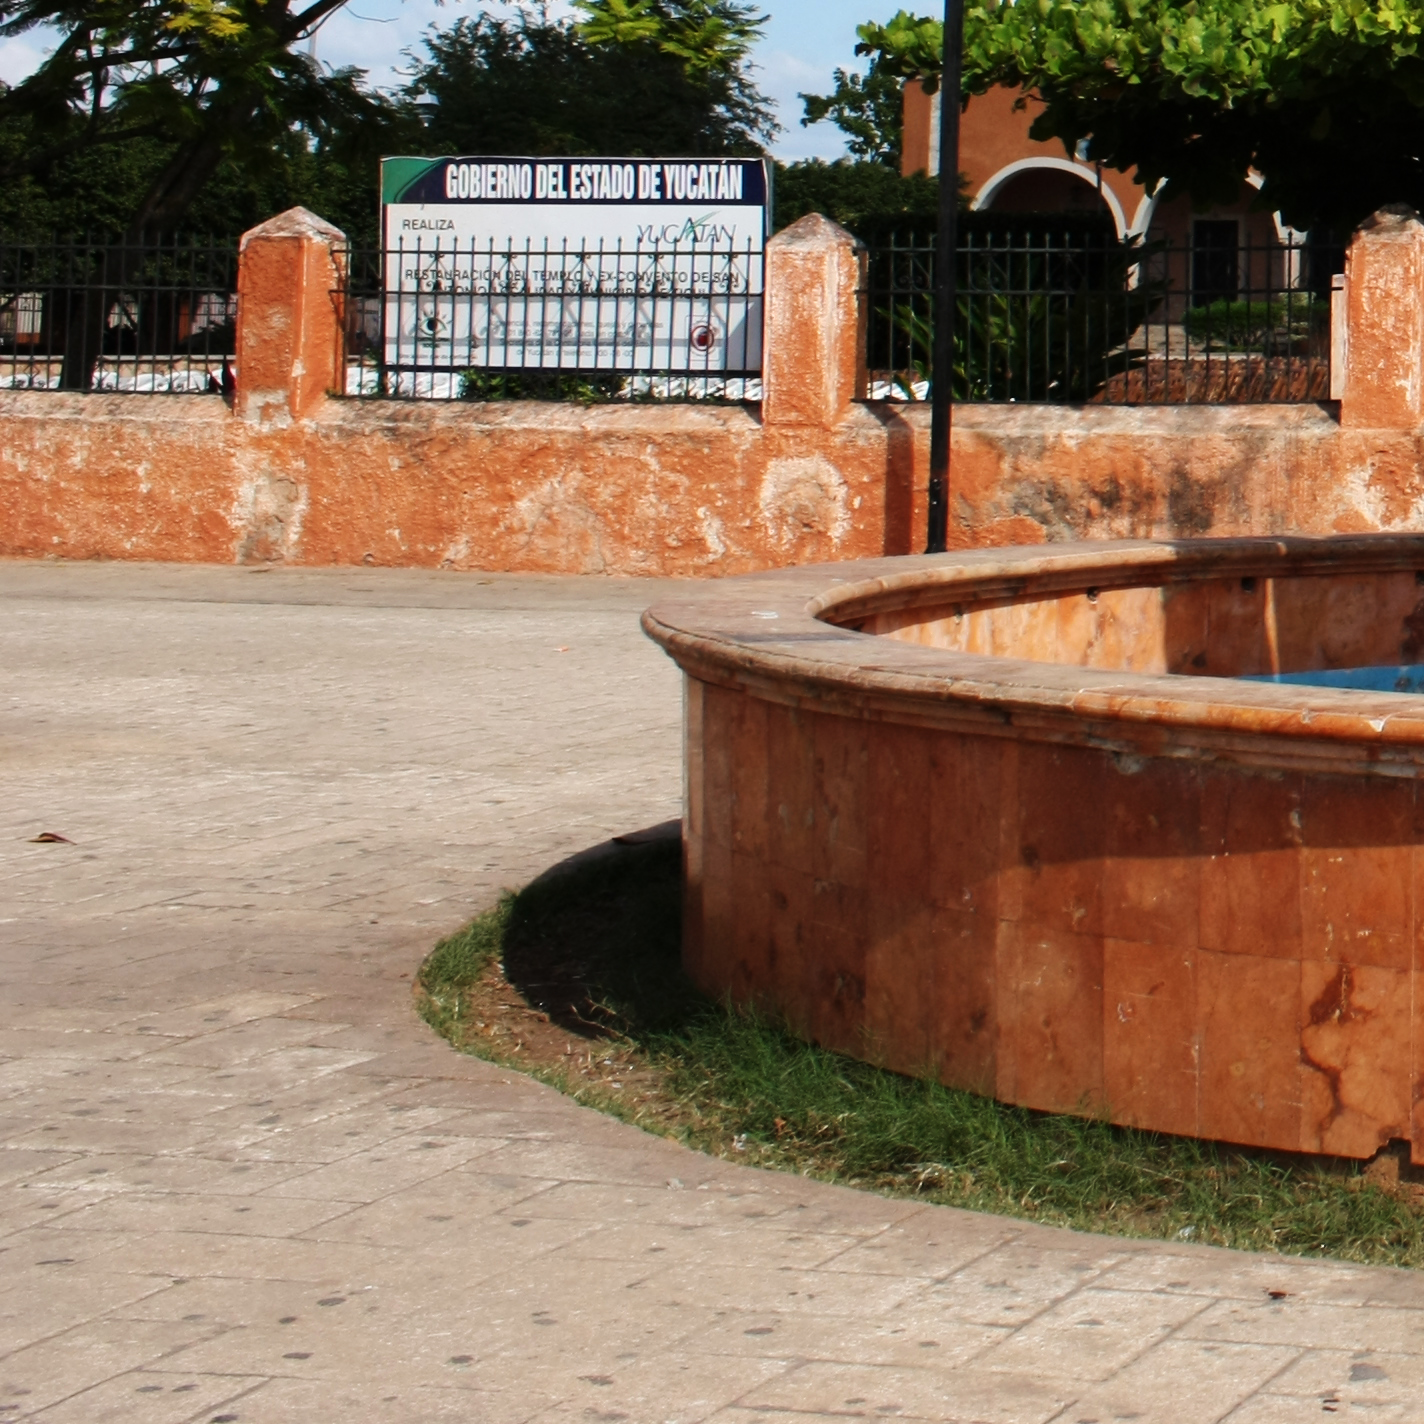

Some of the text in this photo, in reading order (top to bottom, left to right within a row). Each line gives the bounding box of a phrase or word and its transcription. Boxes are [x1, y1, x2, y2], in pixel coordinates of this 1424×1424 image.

[446, 160, 743, 199] GOBIERNO DEL ESTADO DE YUCATÁN
[402, 219, 455, 231] REALIZA
[405, 266, 739, 283] RESTAURACIÓN DEL TEMPLO Y EX-CONVENTO DE SAN
